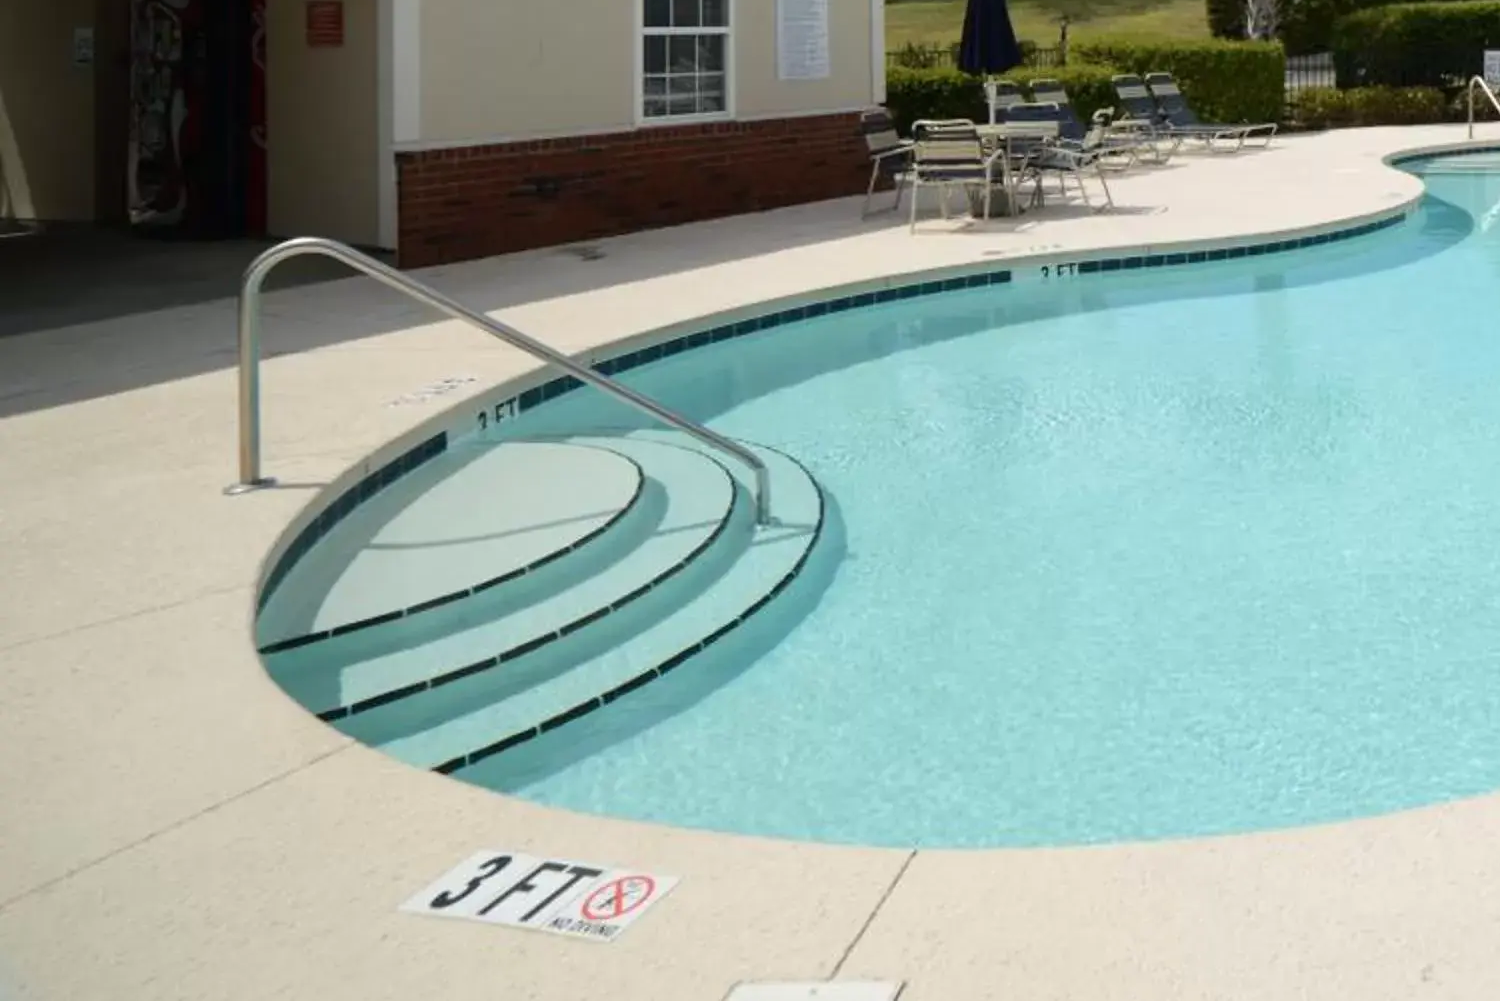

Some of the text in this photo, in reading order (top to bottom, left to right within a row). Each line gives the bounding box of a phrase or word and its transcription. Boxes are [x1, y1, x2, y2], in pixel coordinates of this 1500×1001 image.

[495, 396, 517, 424] FT
[430, 855, 603, 922] 3 FT
[549, 917, 573, 929] NO
